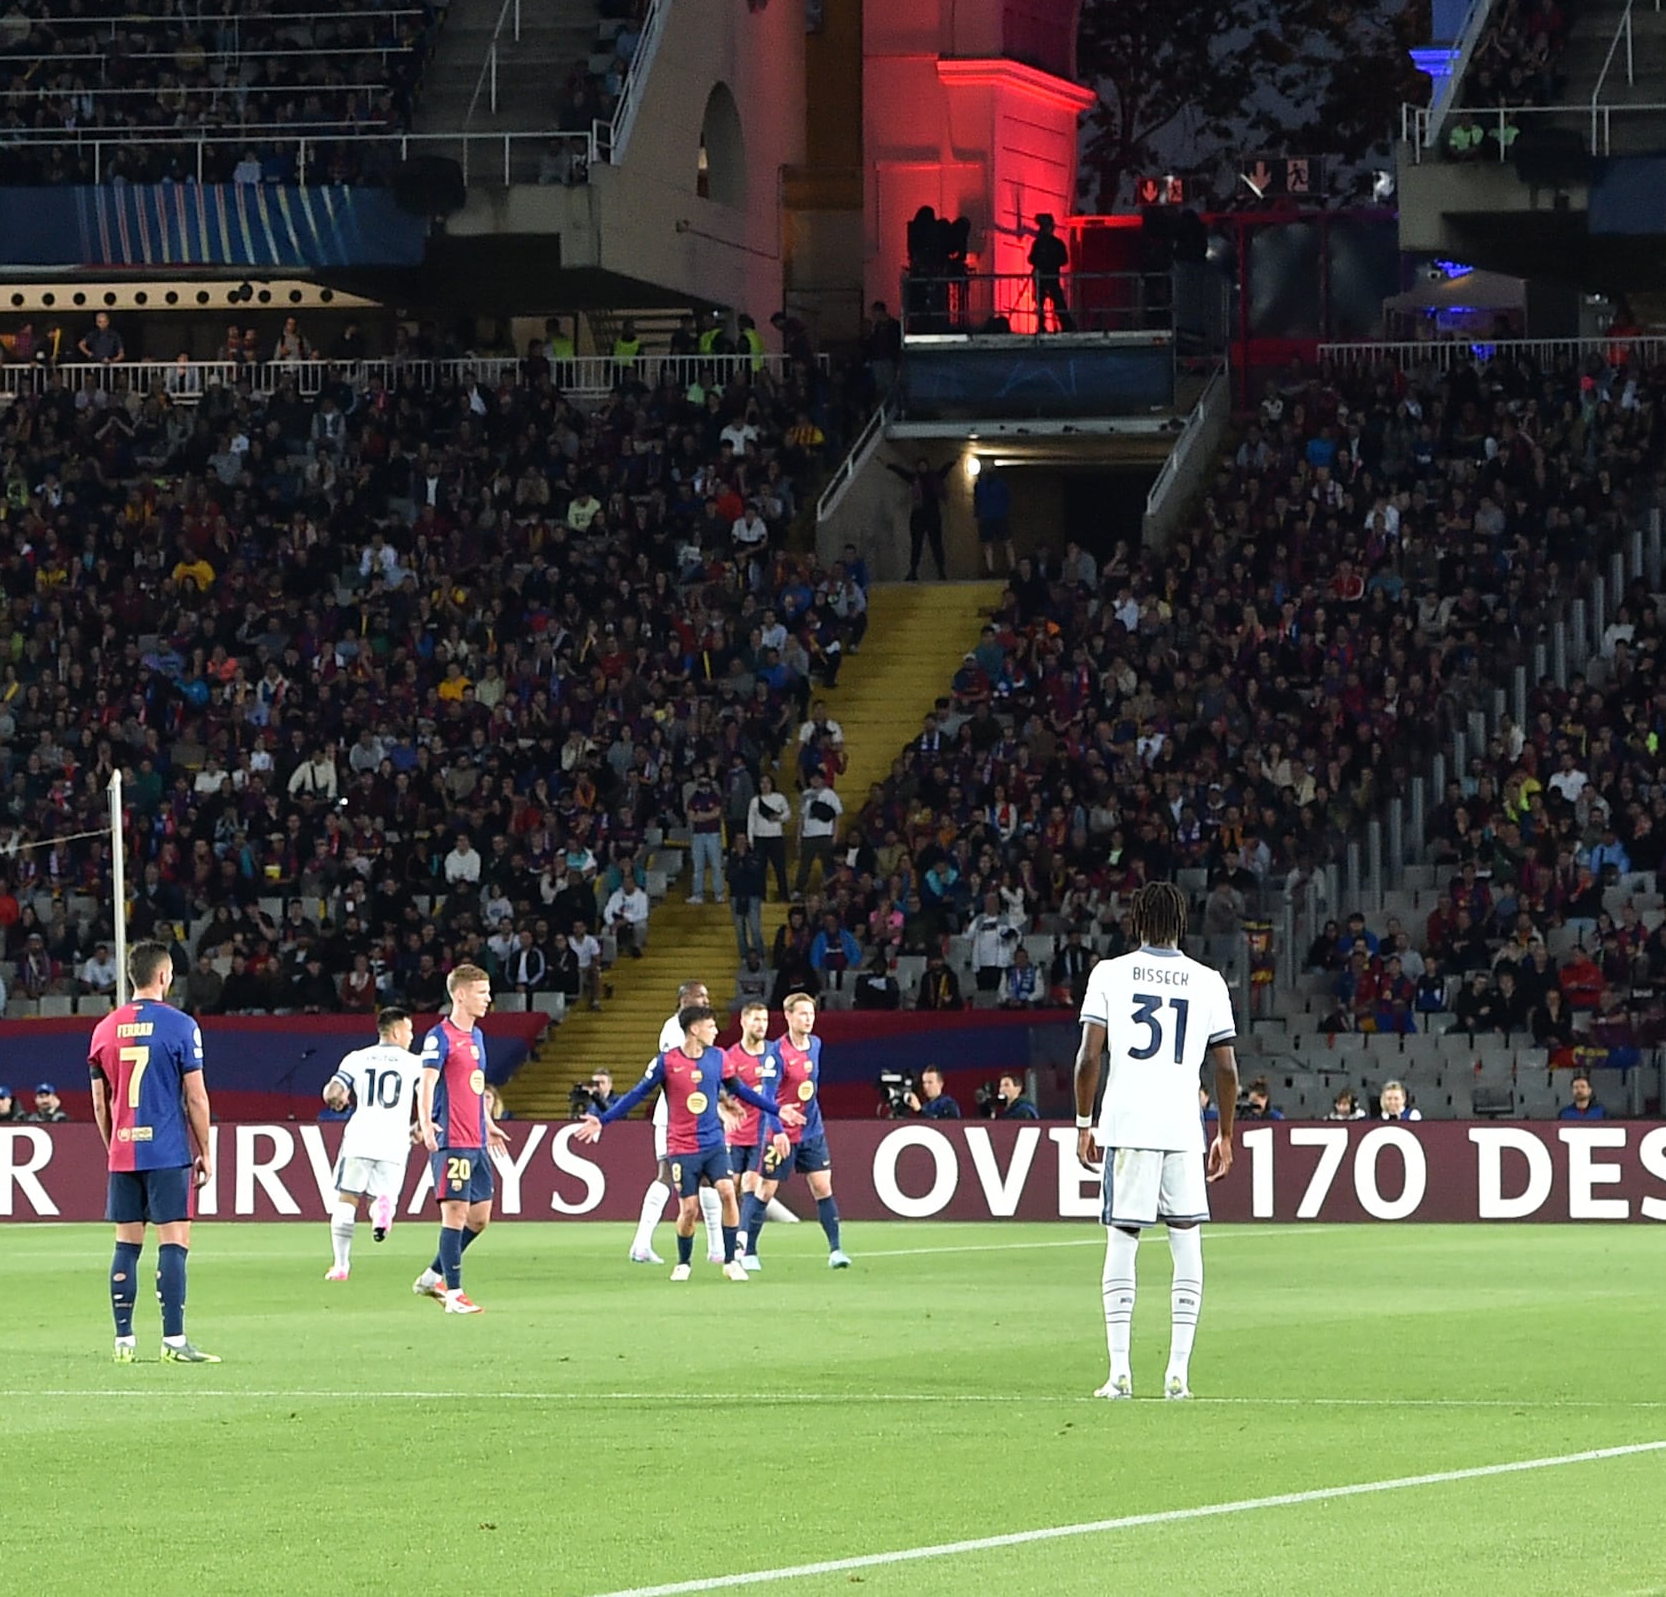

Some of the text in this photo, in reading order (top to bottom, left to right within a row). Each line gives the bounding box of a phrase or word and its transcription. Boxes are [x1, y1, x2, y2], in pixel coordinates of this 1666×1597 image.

[1133, 966, 1189, 987] BISSECK
[1127, 993, 1189, 1065] 31
[120, 1046, 149, 1108] 7
[364, 1068, 402, 1109] 10
[447, 1157, 471, 1180] 20
[872, 1123, 1103, 1219] OVE
[1242, 1125, 1427, 1220] 170
